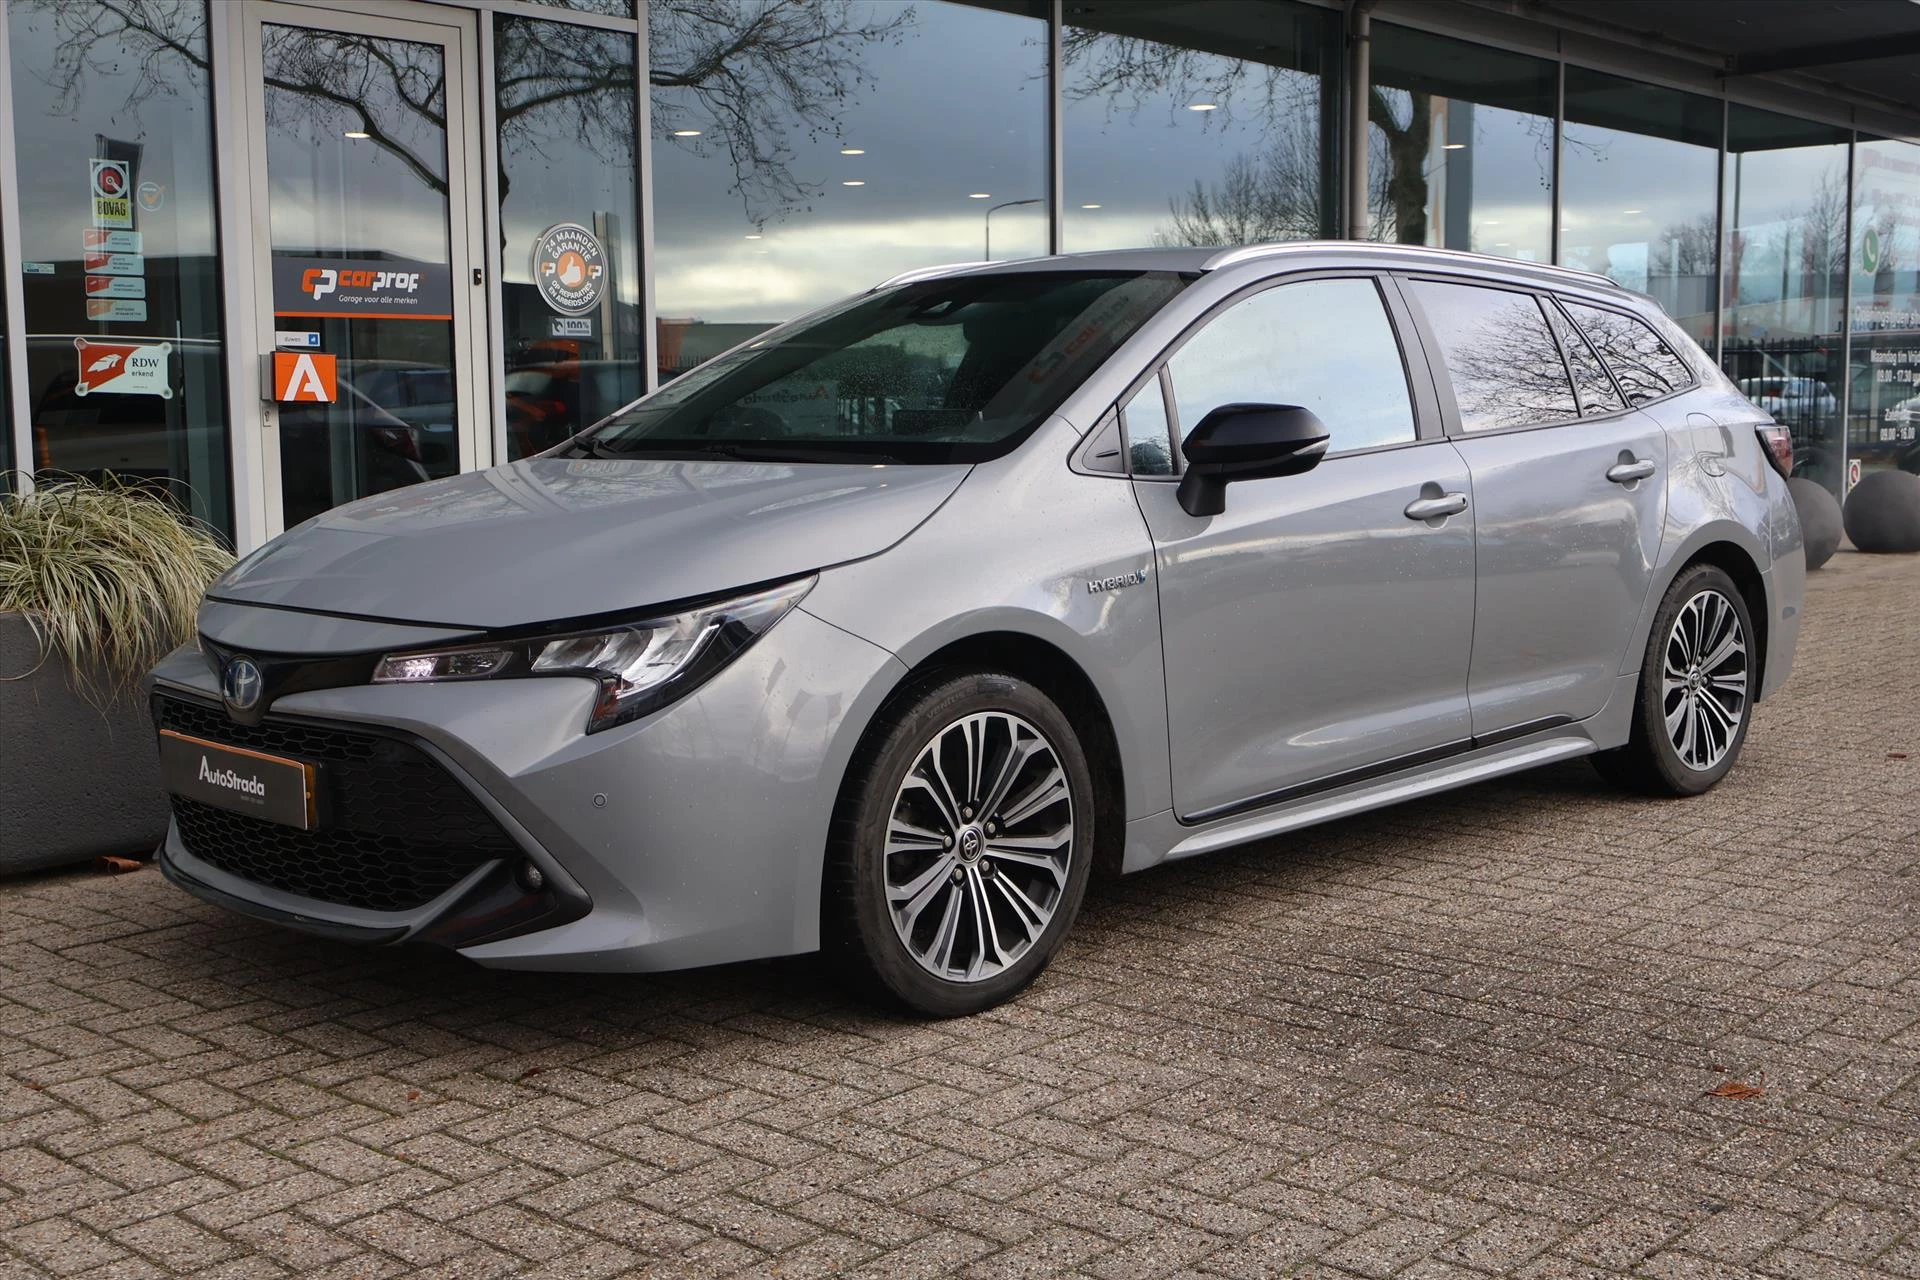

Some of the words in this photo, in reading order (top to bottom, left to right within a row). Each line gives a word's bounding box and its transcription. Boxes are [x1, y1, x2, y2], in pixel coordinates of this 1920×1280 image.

[97, 200, 126, 217] BOVAG
[545, 239, 556, 253] 24
[556, 231, 598, 257] MAANDEN
[552, 241, 592, 262] GARANTIE
[338, 270, 420, 293] carprof
[551, 280, 560, 291] OP
[559, 280, 593, 299] REPARATIES
[339, 294, 362, 305] Garage
[380, 296, 393, 304] alle
[394, 296, 418, 305] merken
[548, 286, 557, 298] EN
[555, 289, 596, 307] ARBEIDSLOON
[567, 320, 589, 329] 100%
[132, 357, 159, 368] RDW
[283, 353, 329, 402] A
[1088, 573, 1137, 594] HYBRID
[199, 755, 265, 796] AutoStrada
